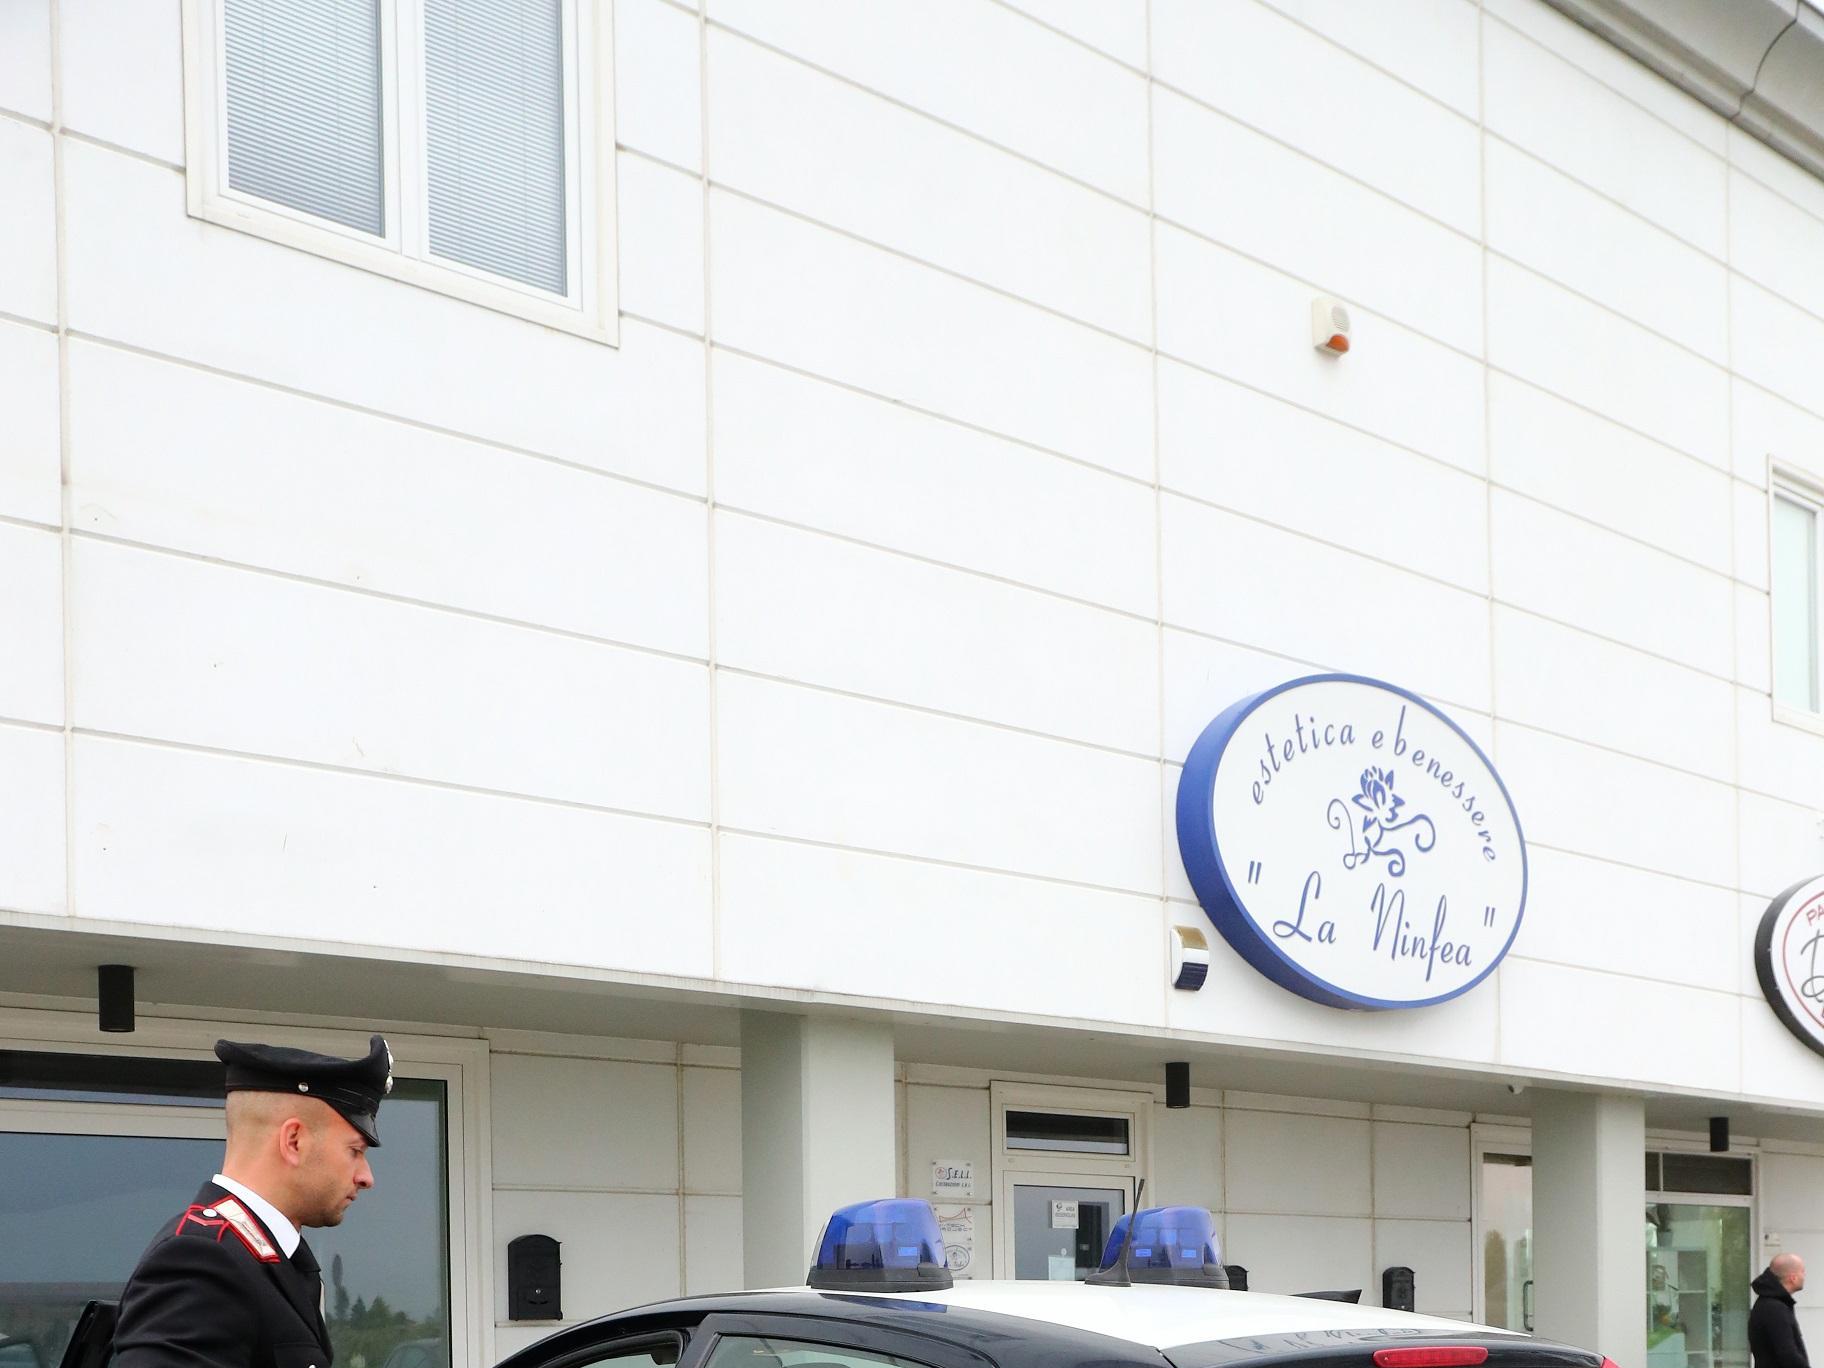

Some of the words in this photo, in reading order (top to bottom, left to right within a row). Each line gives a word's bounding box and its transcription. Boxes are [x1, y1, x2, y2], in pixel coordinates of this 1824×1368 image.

[1252, 713, 1356, 806] estetica
[1371, 730, 1385, 749] e
[1393, 705, 1497, 863] benessere
